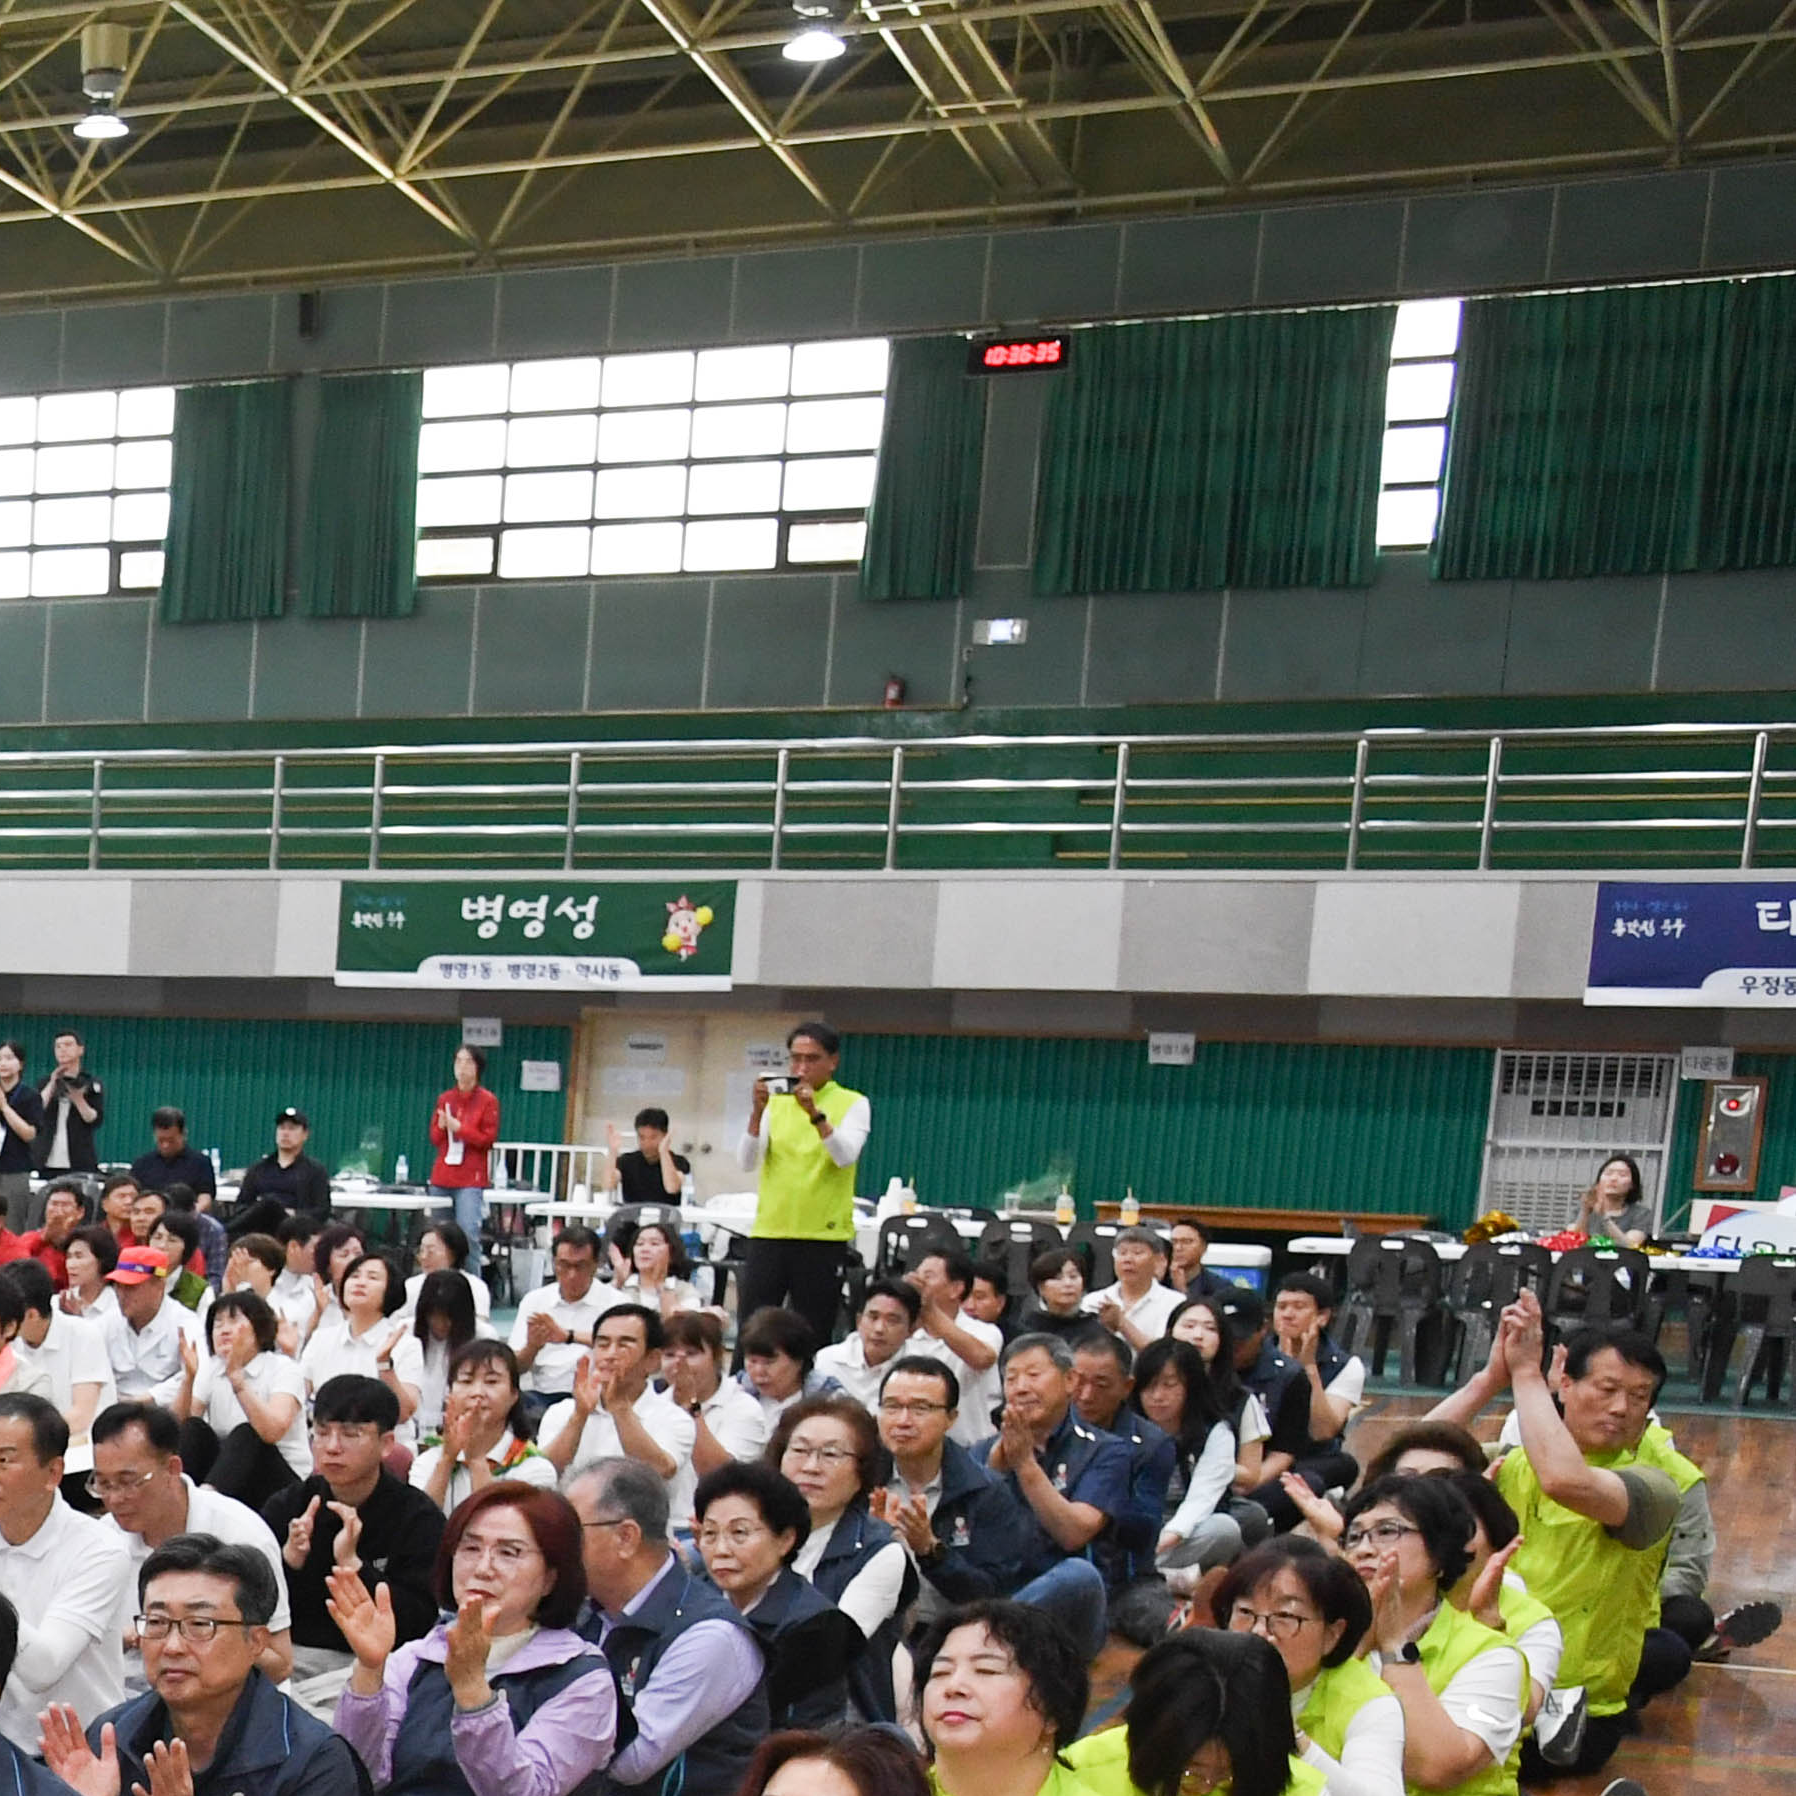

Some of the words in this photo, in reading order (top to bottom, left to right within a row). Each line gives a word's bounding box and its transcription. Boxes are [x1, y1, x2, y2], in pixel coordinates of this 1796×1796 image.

[461, 893, 600, 939] 병영성
[439, 962, 492, 980] 병영1동
[507, 963, 561, 981] 병영2동
